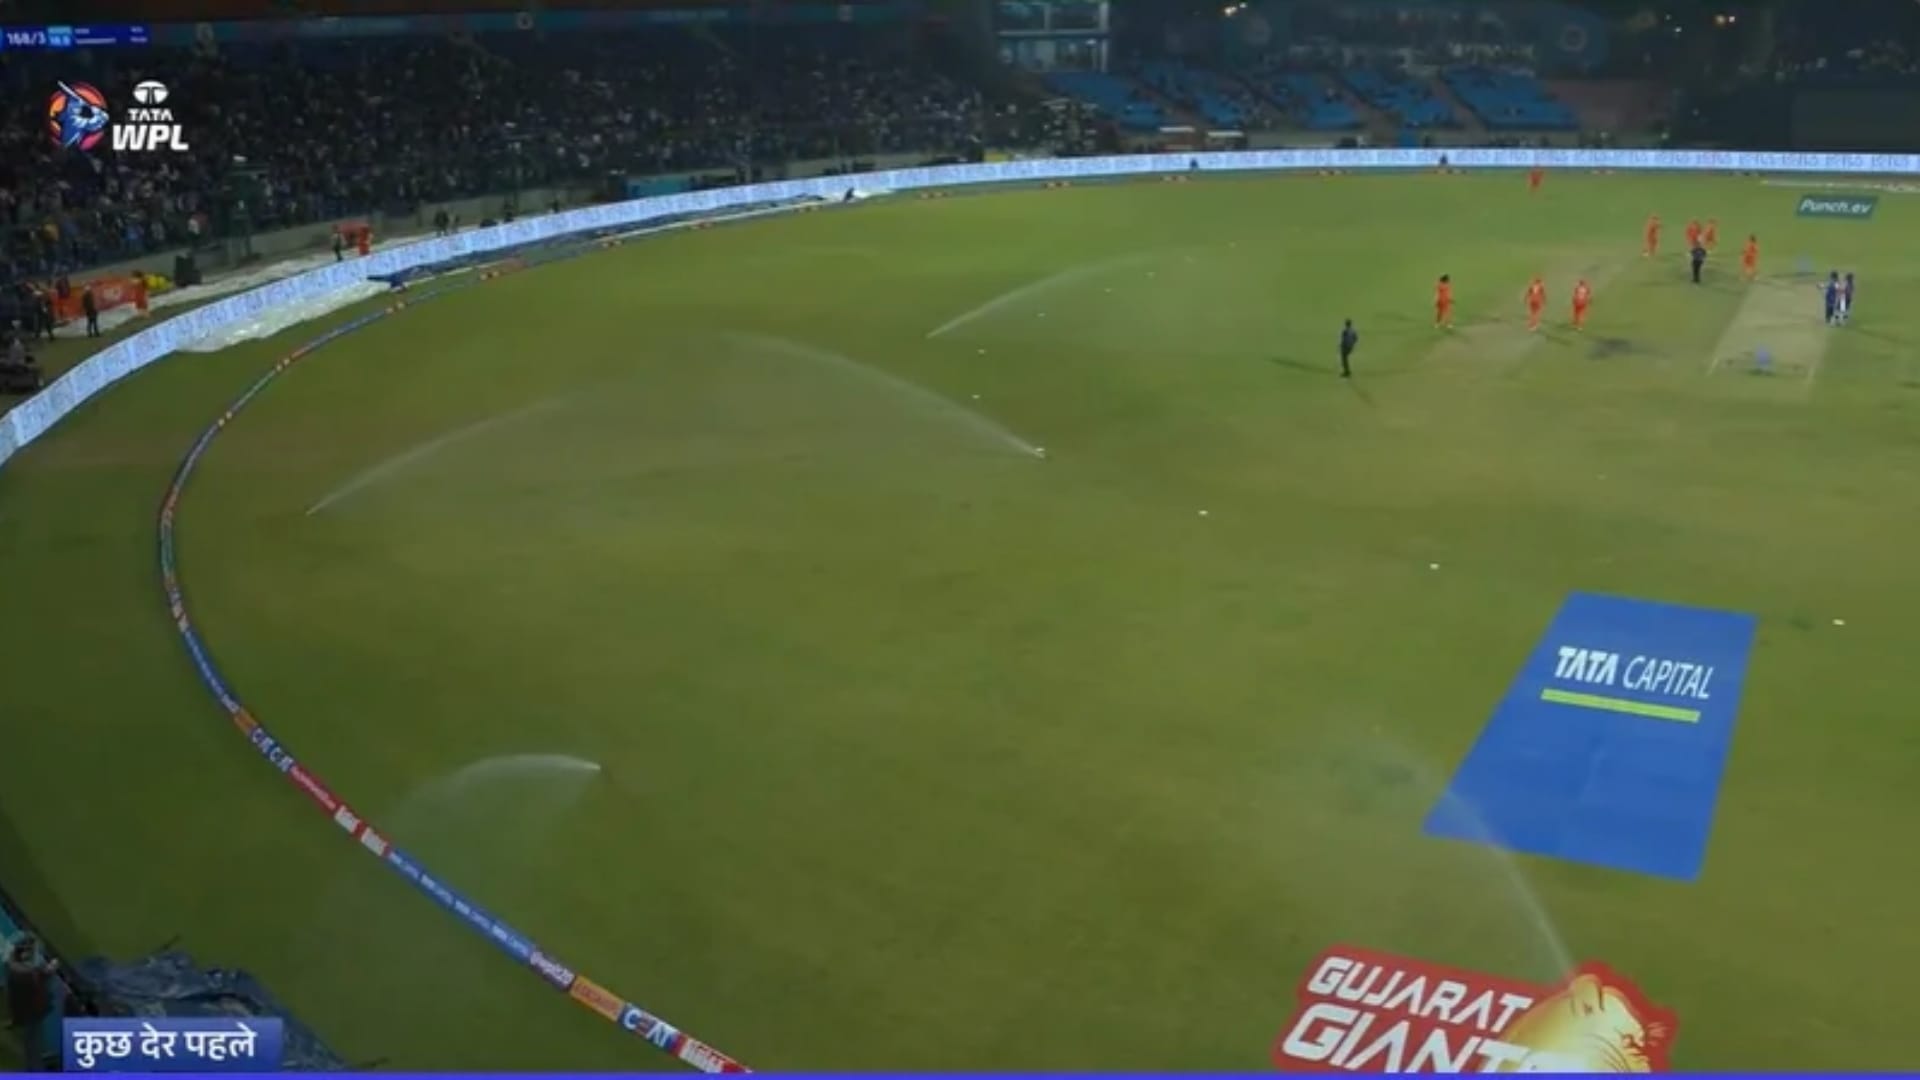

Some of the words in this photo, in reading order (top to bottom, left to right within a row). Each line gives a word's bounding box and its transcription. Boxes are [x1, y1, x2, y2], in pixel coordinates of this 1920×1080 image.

[1800, 198, 1872, 214] Punch.ev
[1554, 646, 1619, 685] TATA
[1622, 656, 1714, 699] CAPITAL
[1307, 956, 1534, 1033] GUJARAT
[1282, 1002, 1566, 1073] GIANT
